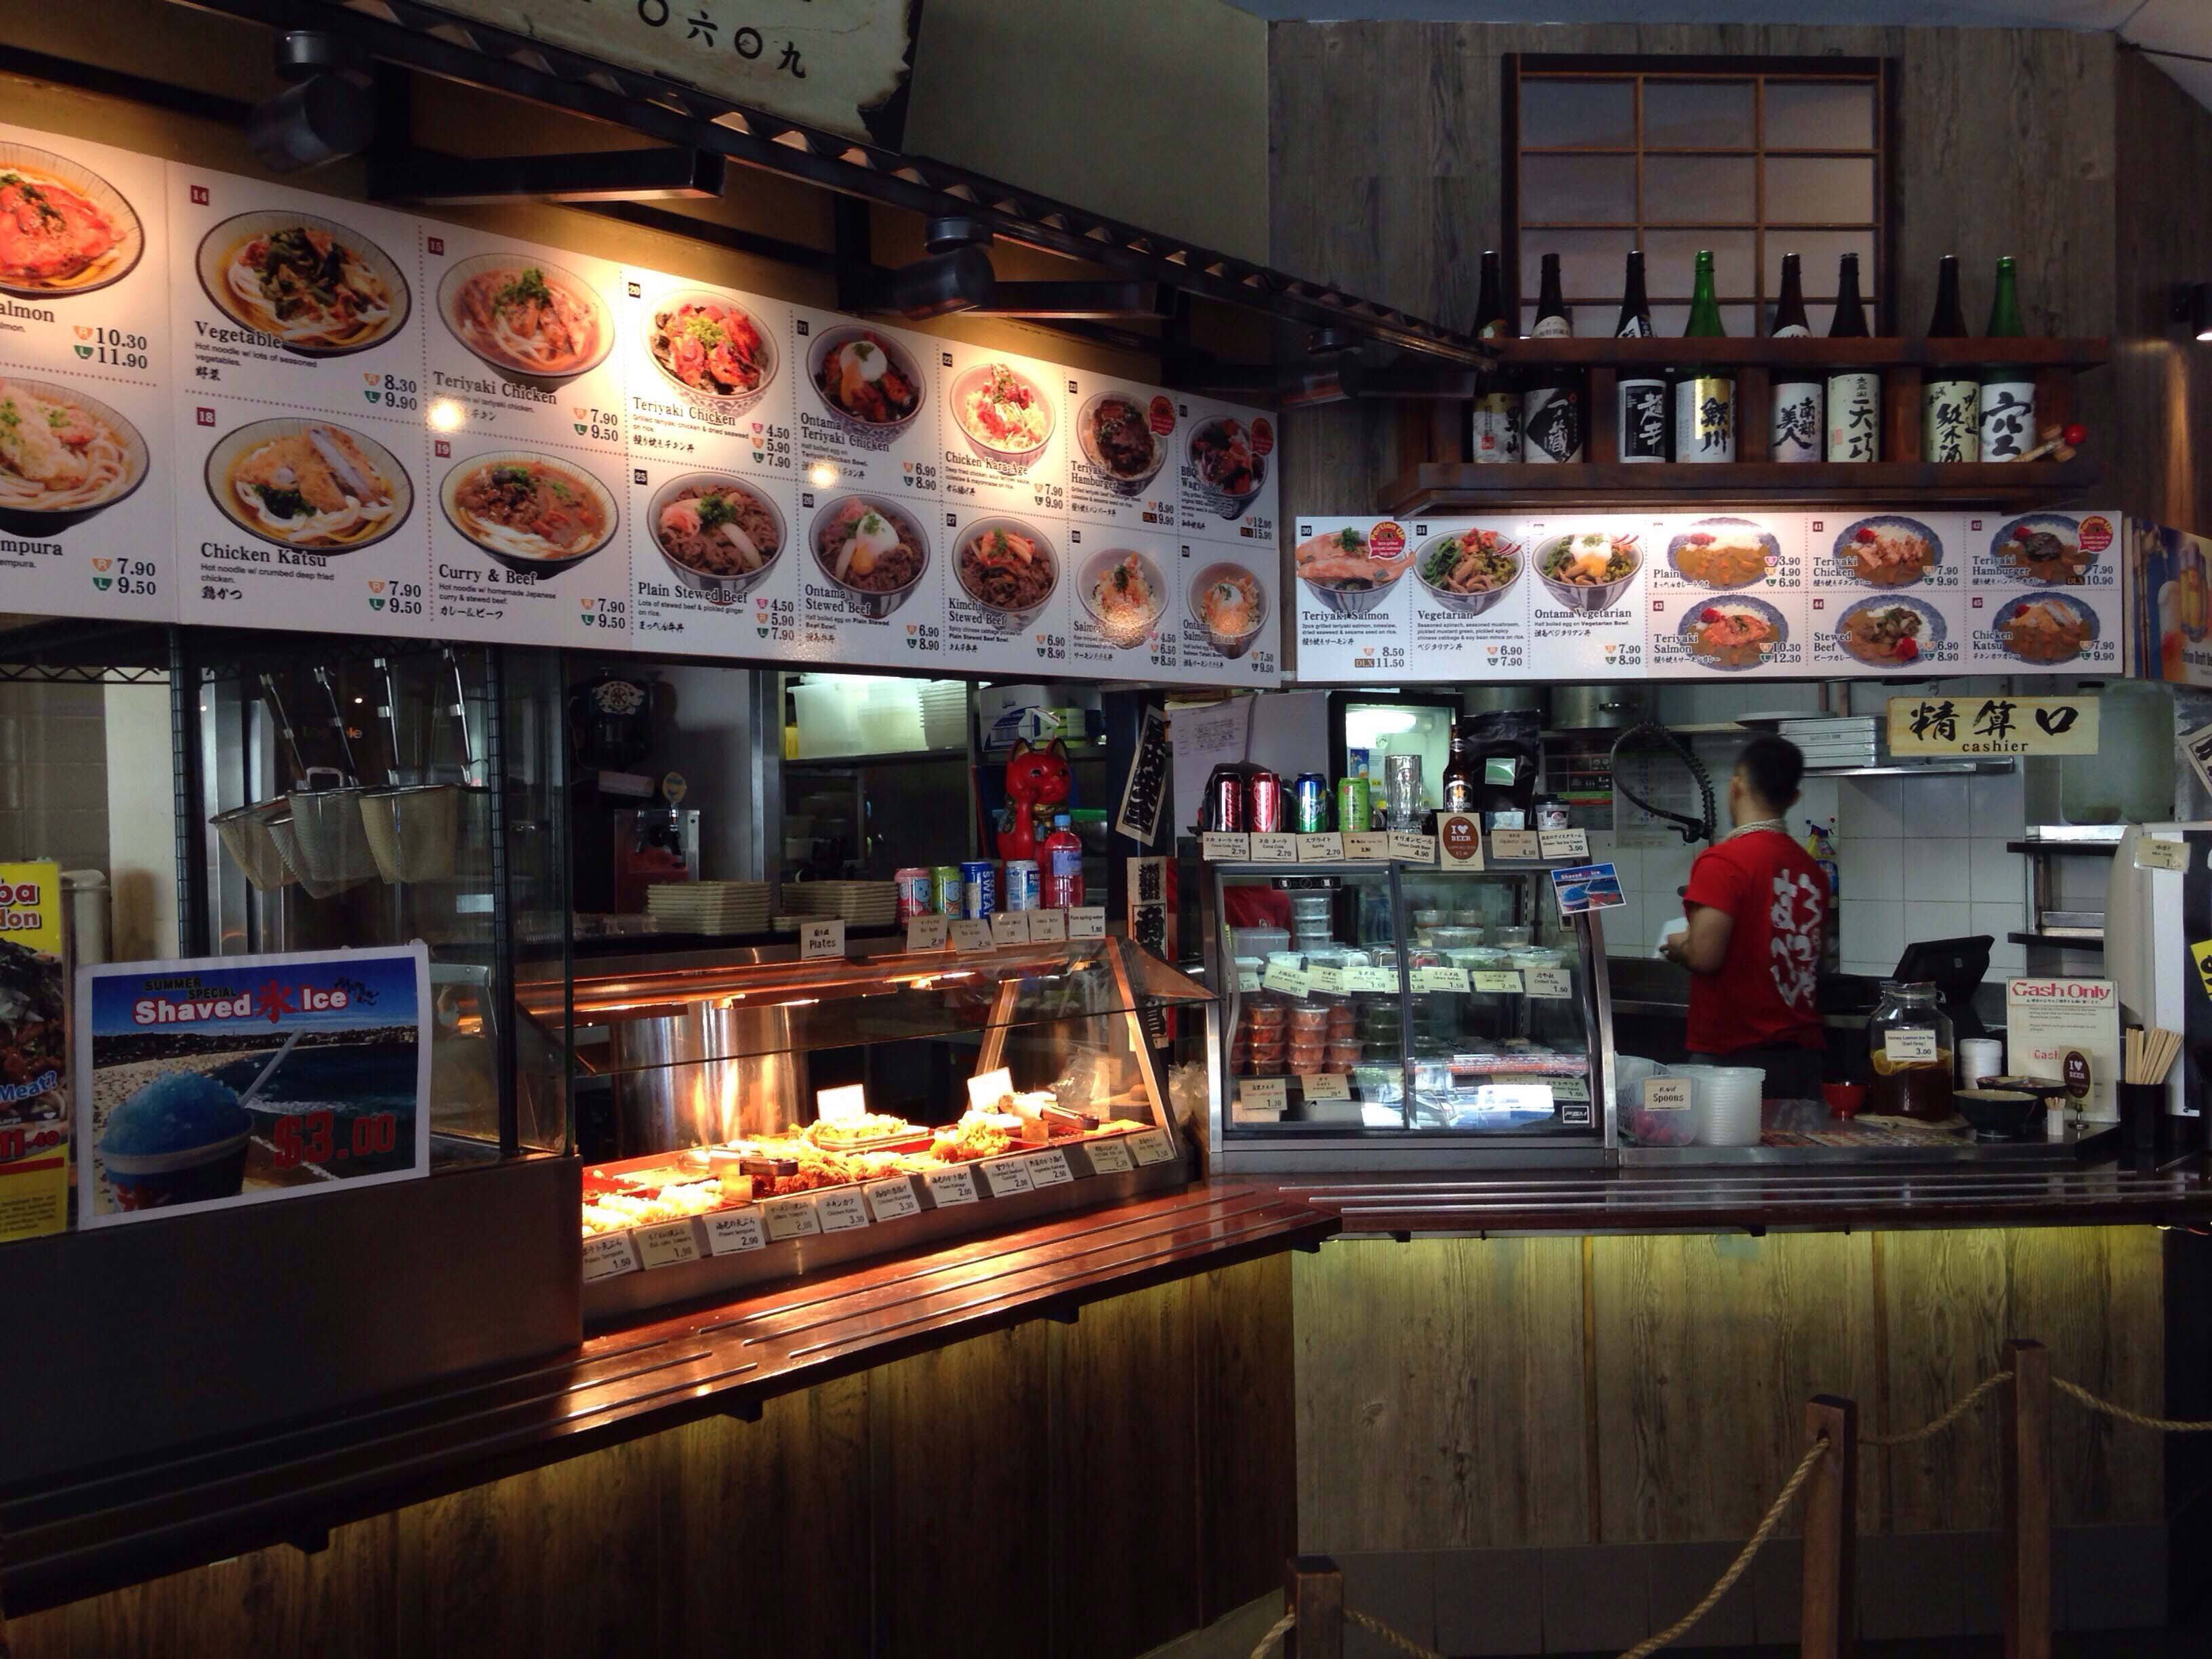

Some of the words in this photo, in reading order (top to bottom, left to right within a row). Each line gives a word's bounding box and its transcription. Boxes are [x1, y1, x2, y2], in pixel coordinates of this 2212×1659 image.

[96, 327, 147, 350] 10.30
[194, 321, 283, 349] Vegetable
[211, 344, 241, 356] noodle
[98, 347, 148, 369] 11.90
[384, 374, 417, 394] 8.30
[433, 371, 496, 394] Teriyaki
[501, 383, 558, 405] Chicken
[385, 391, 417, 411] 9.90
[199, 411, 214, 424] 18
[591, 409, 618, 426] 7.90
[633, 397, 684, 417] Teriyaki
[689, 407, 736, 426] Chicken
[801, 412, 842, 430] Ontama
[592, 425, 619, 441] 9.50
[766, 424, 790, 440] 4.50
[801, 426, 845, 445] Teriyaki
[849, 435, 890, 452] Chicken
[436, 444, 449, 455] 19
[766, 438, 790, 454] 5.90
[767, 453, 791, 468] 7.90
[945, 451, 982, 468] Chicken
[916, 463, 936, 476] 6.90
[1071, 460, 1107, 476] Teriyaki
[916, 476, 937, 490] 8.90
[1046, 484, 1063, 497] 7.90
[1046, 497, 1063, 510] 9.90
[201, 542, 270, 562] Chicken
[278, 549, 327, 567] Katsu
[1779, 556, 1800, 565] 3.90
[1973, 556, 2016, 566] Teriyaki
[117, 558, 157, 577] 7.90
[1814, 556, 1858, 567] Teriyaki
[439, 564, 482, 582] Curry
[488, 569, 499, 582] &
[506, 570, 537, 585] Beef
[1654, 569, 1680, 579] Plain
[1779, 567, 1800, 576] 4.90
[1814, 567, 1854, 576] Chicken
[1937, 566, 1959, 575] 7.90
[1973, 566, 2030, 577] Hamburger
[2093, 565, 2113, 575] 7.90
[118, 577, 157, 596] 9.50
[1779, 577, 1800, 588] 6.90
[1937, 576, 1959, 586] 9.90
[2087, 575, 2114, 586] 10.90
[389, 581, 422, 598] 7.90
[638, 582, 670, 597] Plain
[675, 586, 718, 602] Stewed
[723, 590, 747, 603] Beef
[805, 584, 846, 599] Ontama
[390, 598, 422, 615] 9.50
[598, 598, 625, 613] 7.90
[771, 598, 794, 612] 4.50
[805, 598, 844, 613] Stewed
[848, 601, 872, 615] Beef
[949, 598, 982, 611] Kimchi
[771, 612, 794, 627] 5.90
[949, 611, 982, 624] Stewed
[986, 613, 1006, 626] Beef
[1303, 611, 1348, 622] Teriyaki
[1351, 611, 1389, 620] Salmon
[1418, 611, 1473, 621] Vegetarian
[1534, 609, 1574, 618] Ontama
[1575, 609, 1632, 619] Vegetarian
[598, 614, 626, 629] 9.50
[771, 627, 794, 641] 7.90
[919, 624, 939, 638] 6.90
[1814, 632, 1851, 641] Stewed
[1973, 630, 2012, 640] Chicken
[919, 638, 939, 651] 8.90
[1047, 634, 1065, 647] 6.90
[1654, 634, 1698, 644] Teriyaki
[1973, 640, 2003, 651] Katsu
[2094, 640, 2114, 651] 7.90
[1382, 647, 1405, 656] 8.50
[1500, 646, 1522, 655] 6.90
[1618, 644, 1641, 654] 7.90
[1654, 644, 1692, 653] Salmon
[1774, 643, 1801, 653] 10.30
[1814, 642, 1836, 652] Beef
[1937, 641, 1959, 651] 6.90
[1047, 647, 1065, 659] 8.90
[1774, 653, 1801, 663] 12.30
[1937, 651, 1959, 661] 8.90
[2094, 651, 2114, 661] 9.90
[1376, 658, 1405, 668] 11.50
[1500, 657, 1522, 666] 7.90
[1618, 655, 1641, 665] 8.90
[1909, 700, 2079, 741] 精算口
[1962, 740, 2029, 752] cashier
[809, 937, 837, 950] Plates
[144, 978, 201, 992] SUMMER
[2012, 982, 2064, 997] Cash
[2068, 983, 2111, 1001] Only
[188, 986, 237, 1001] SPECIAL
[135, 994, 251, 1025] Shaved
[302, 988, 348, 1010] Ice
[1653, 1093, 1684, 1102] Spoons
[274, 1109, 396, 1170] $3.00
